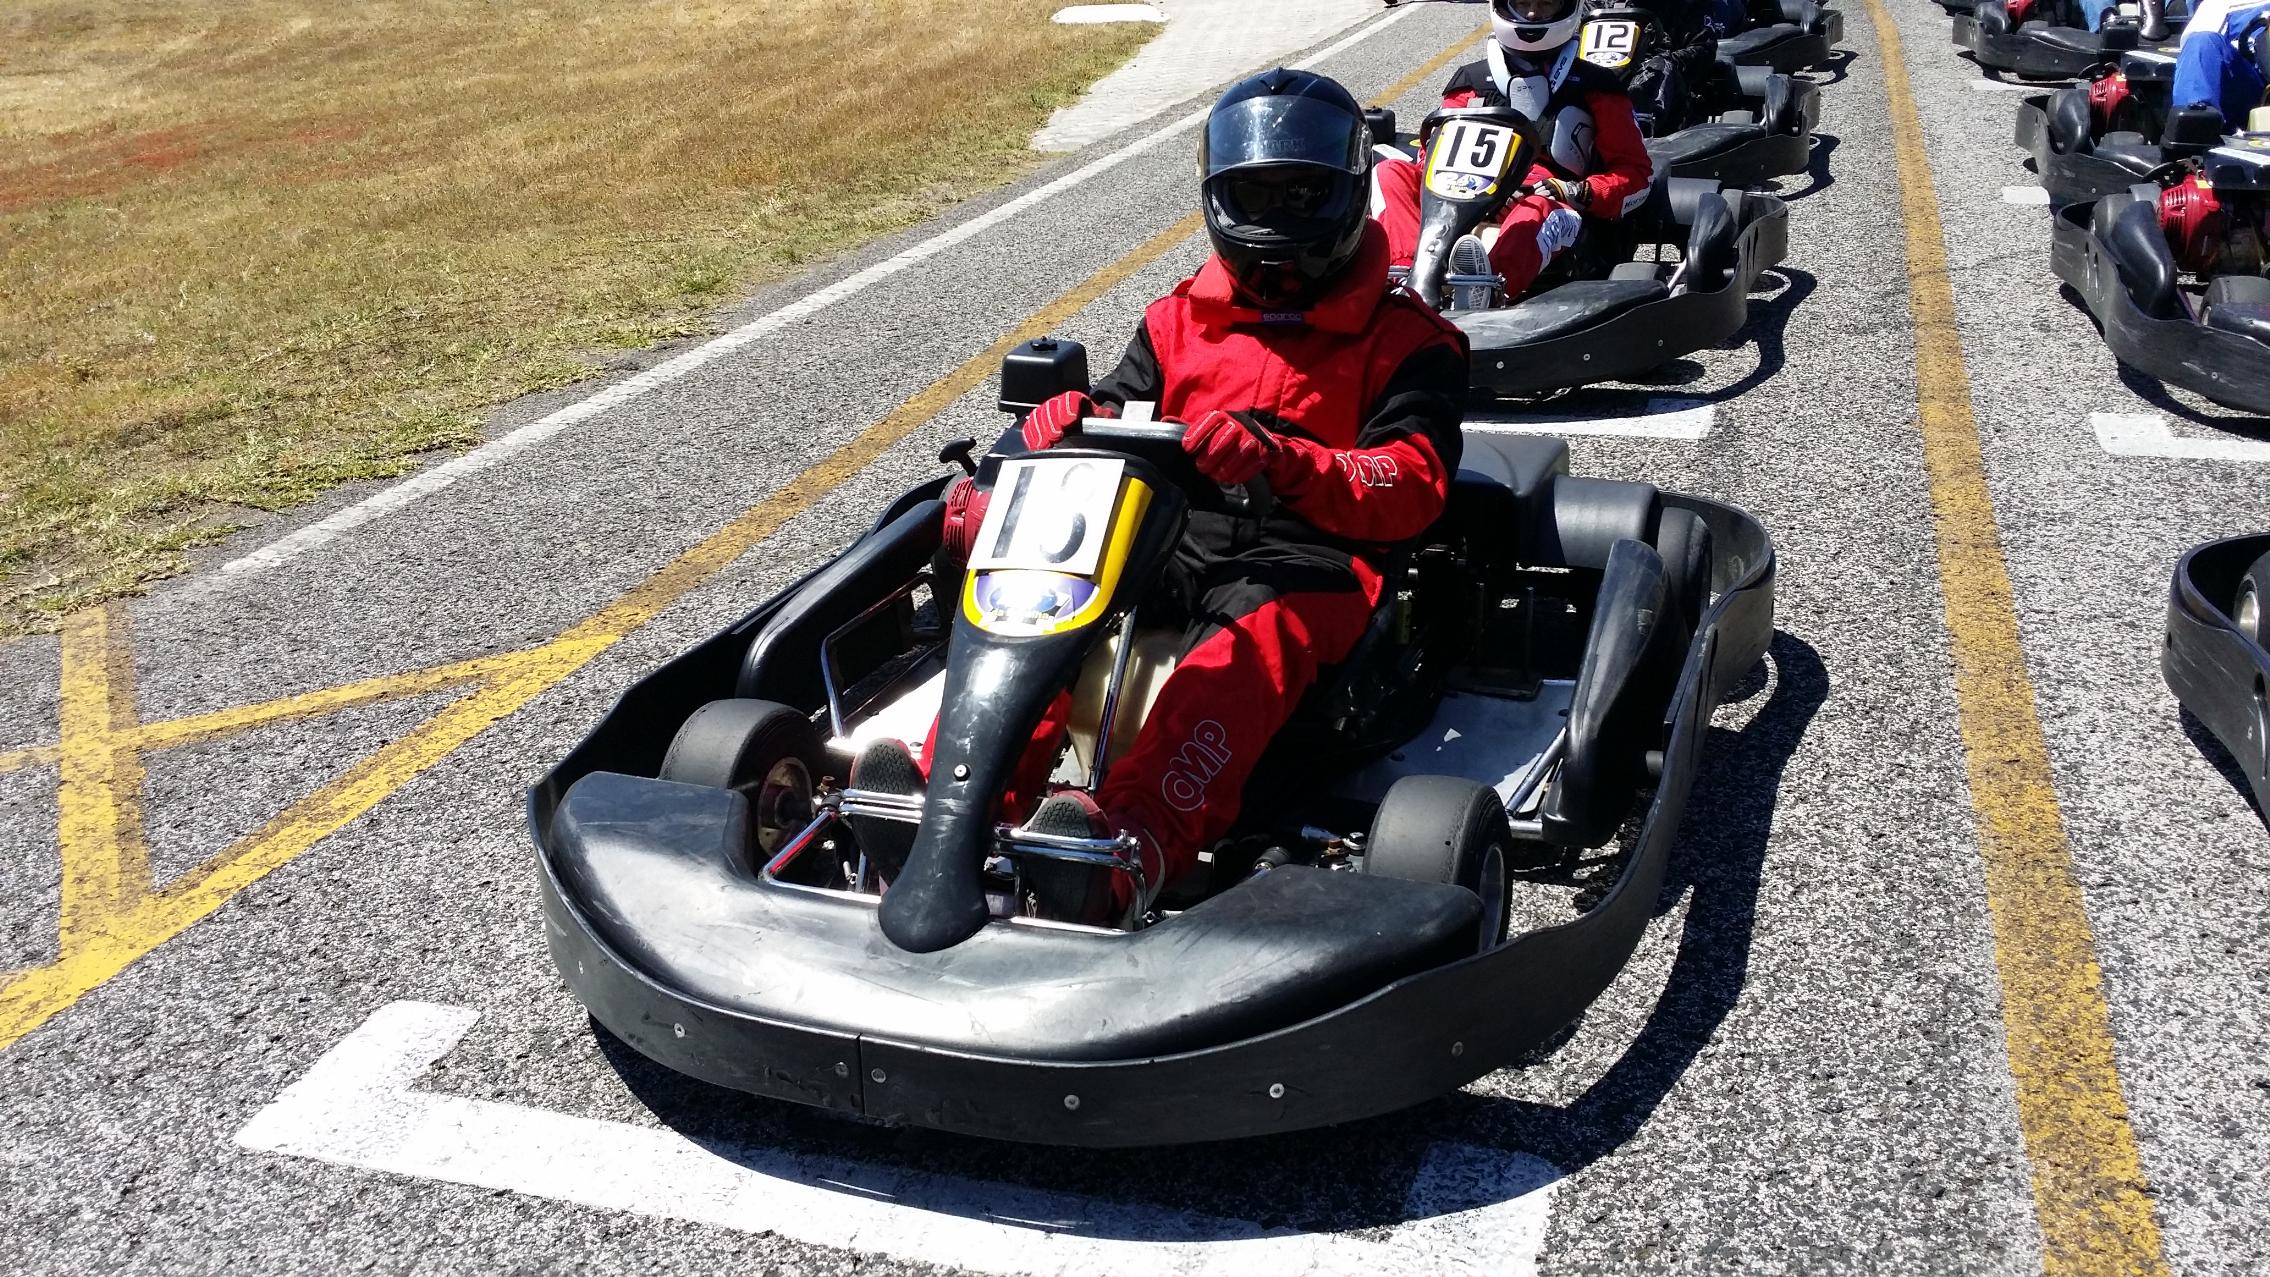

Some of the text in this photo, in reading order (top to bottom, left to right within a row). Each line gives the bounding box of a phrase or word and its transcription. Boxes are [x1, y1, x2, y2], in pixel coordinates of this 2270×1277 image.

[1593, 24, 1629, 49] 12
[1445, 125, 1500, 168] 15
[1162, 719, 1232, 811] OMP
